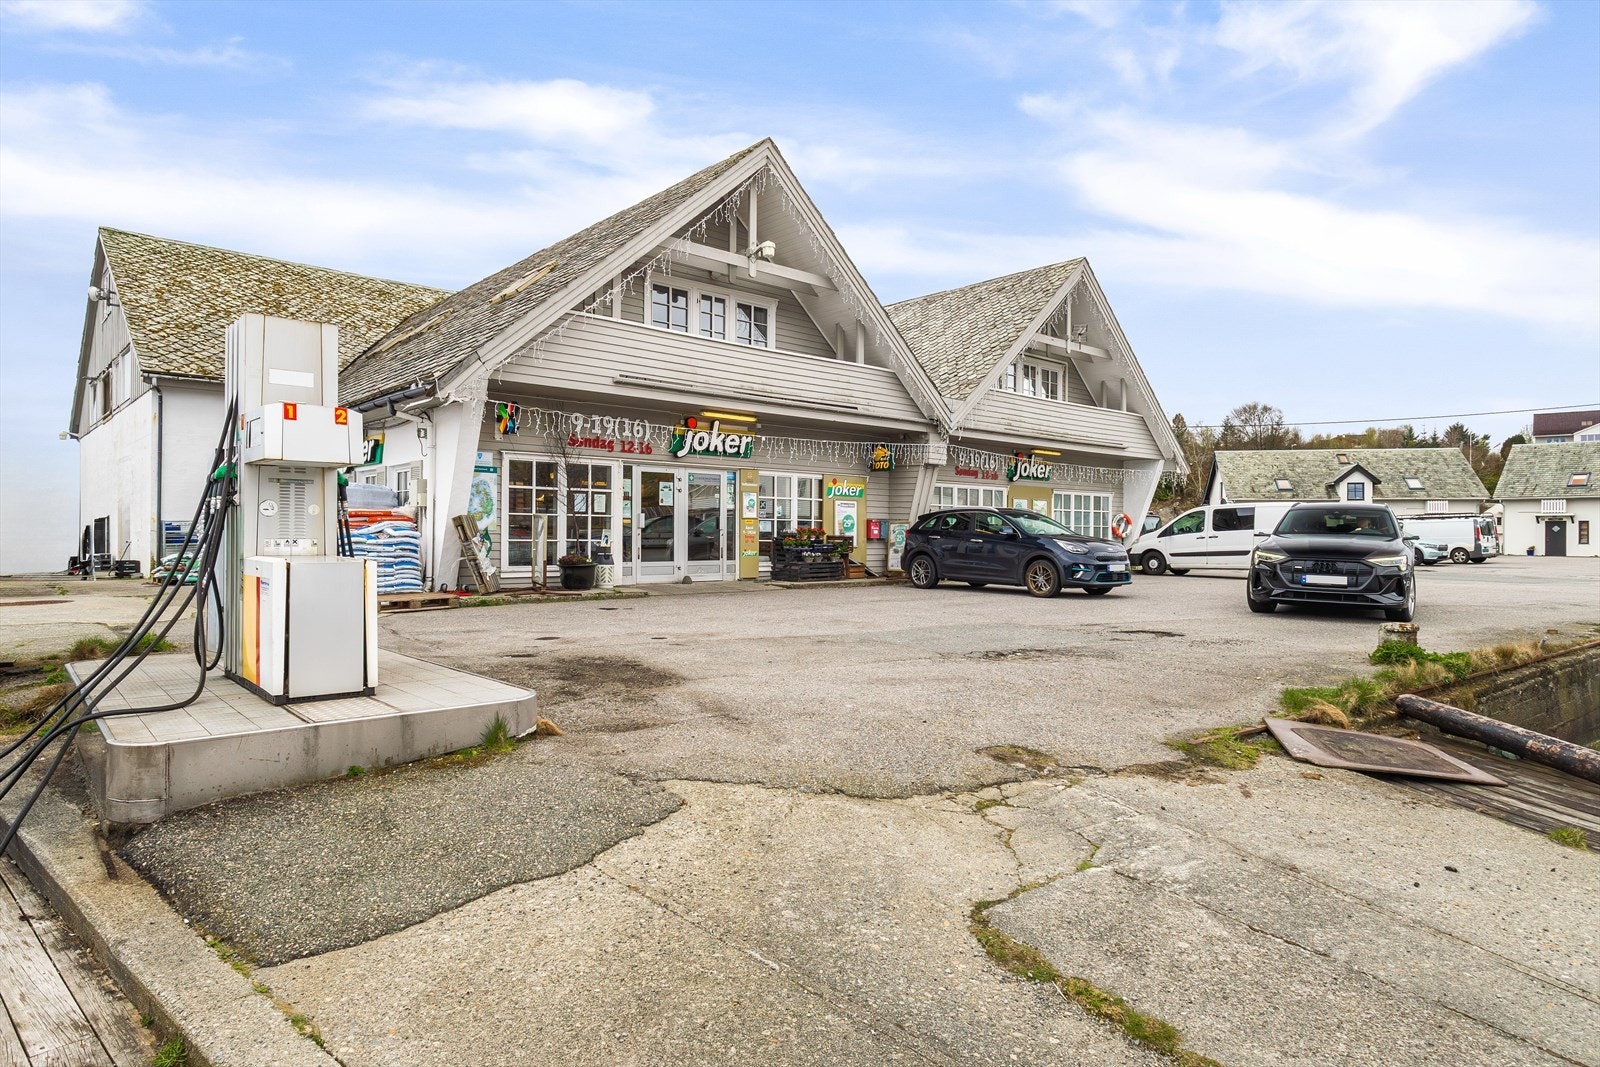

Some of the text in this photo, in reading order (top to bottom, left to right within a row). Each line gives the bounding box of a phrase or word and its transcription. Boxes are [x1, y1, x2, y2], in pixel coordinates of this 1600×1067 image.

[287, 405, 294, 419] 1
[335, 409, 347, 423] 2
[571, 412, 650, 442] 9-19(16)
[676, 416, 753, 458] joker
[1012, 451, 1053, 482] joker
[828, 478, 862, 499] joker
